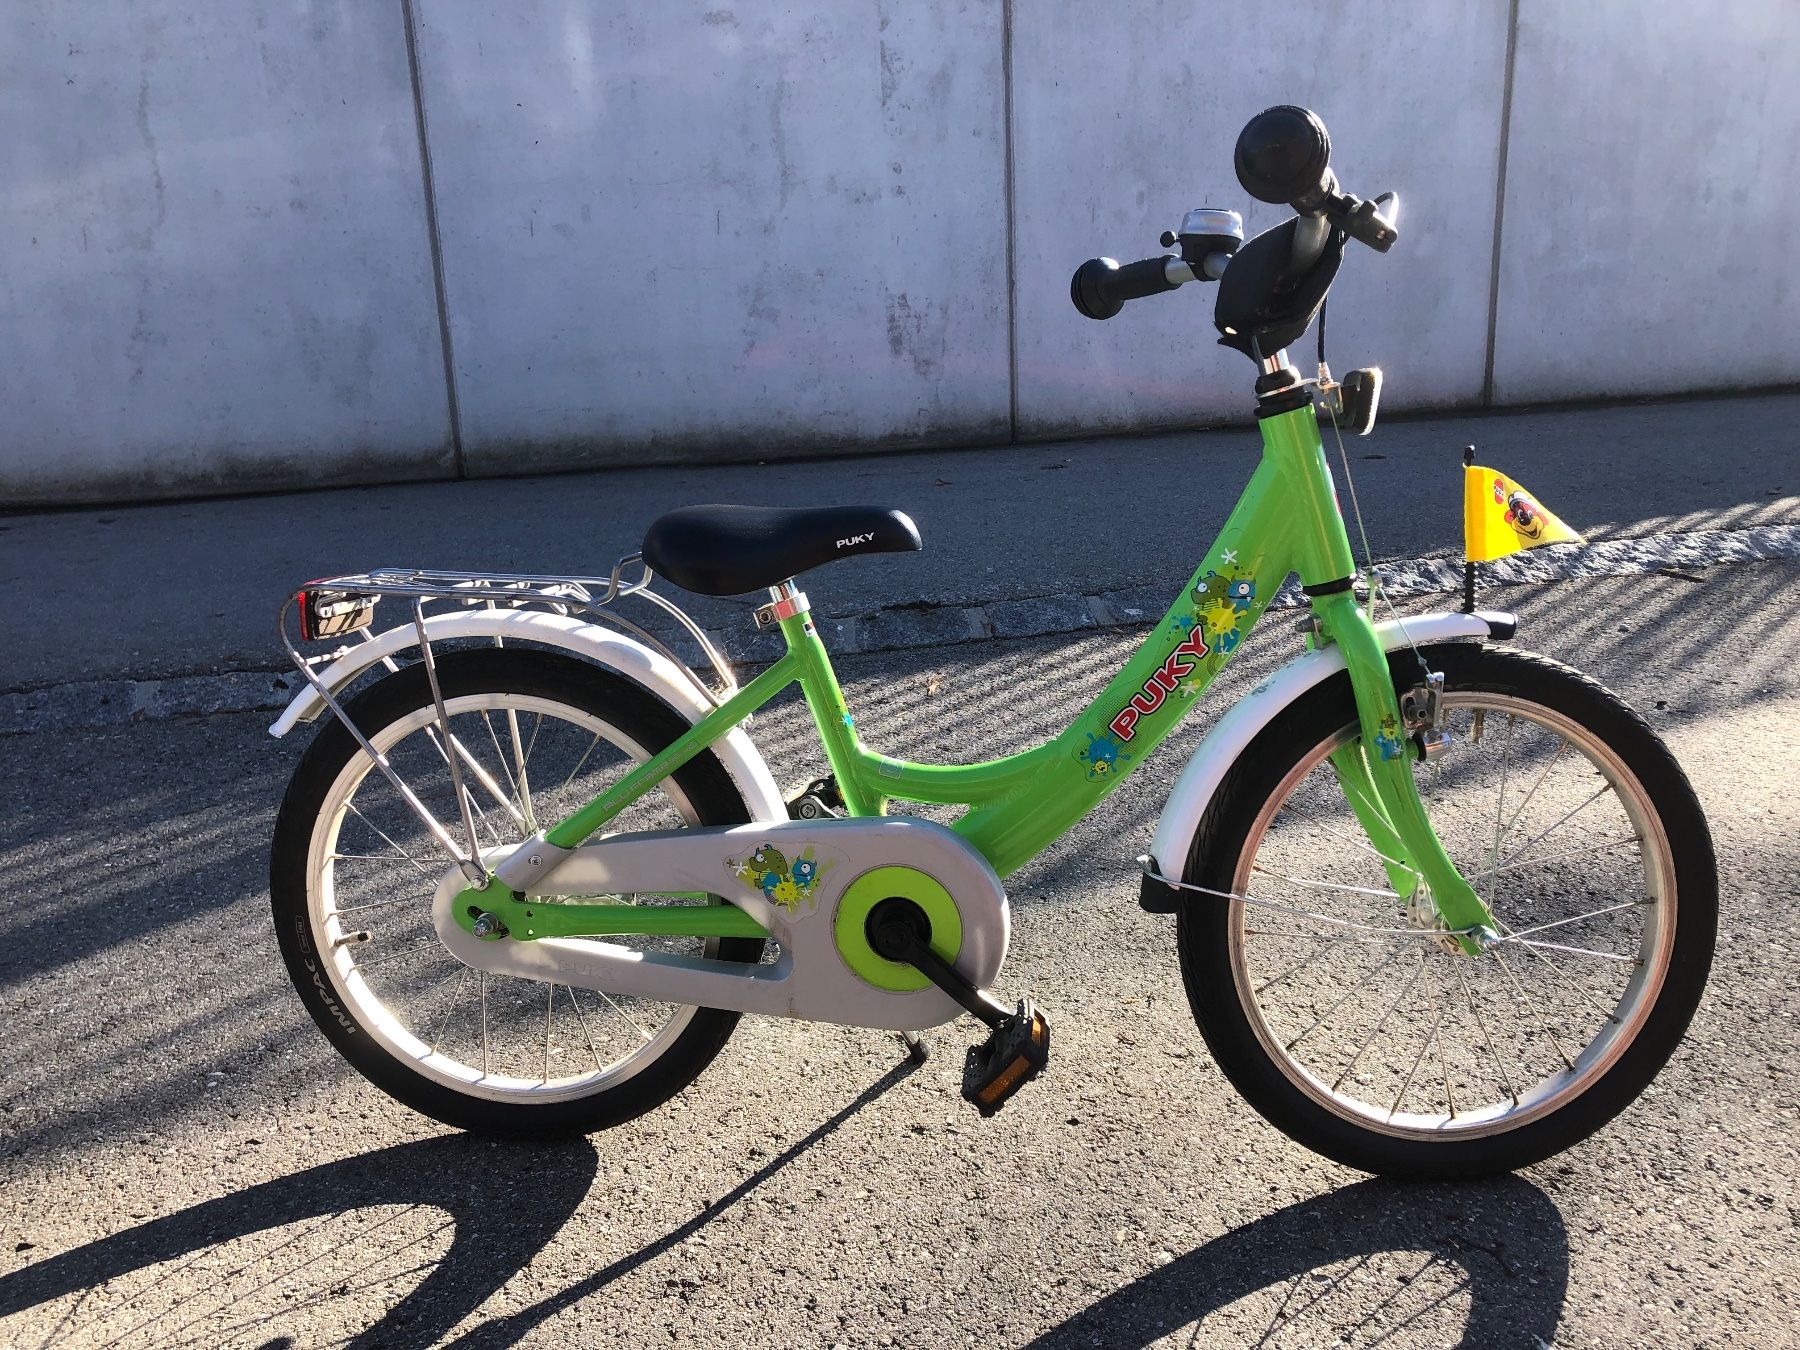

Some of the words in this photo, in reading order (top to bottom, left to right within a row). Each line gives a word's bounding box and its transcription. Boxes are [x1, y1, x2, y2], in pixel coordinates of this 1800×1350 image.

[836, 532, 875, 549] PUKY
[1109, 624, 1209, 741] PUKY
[305, 959, 357, 1035] IMPAC
